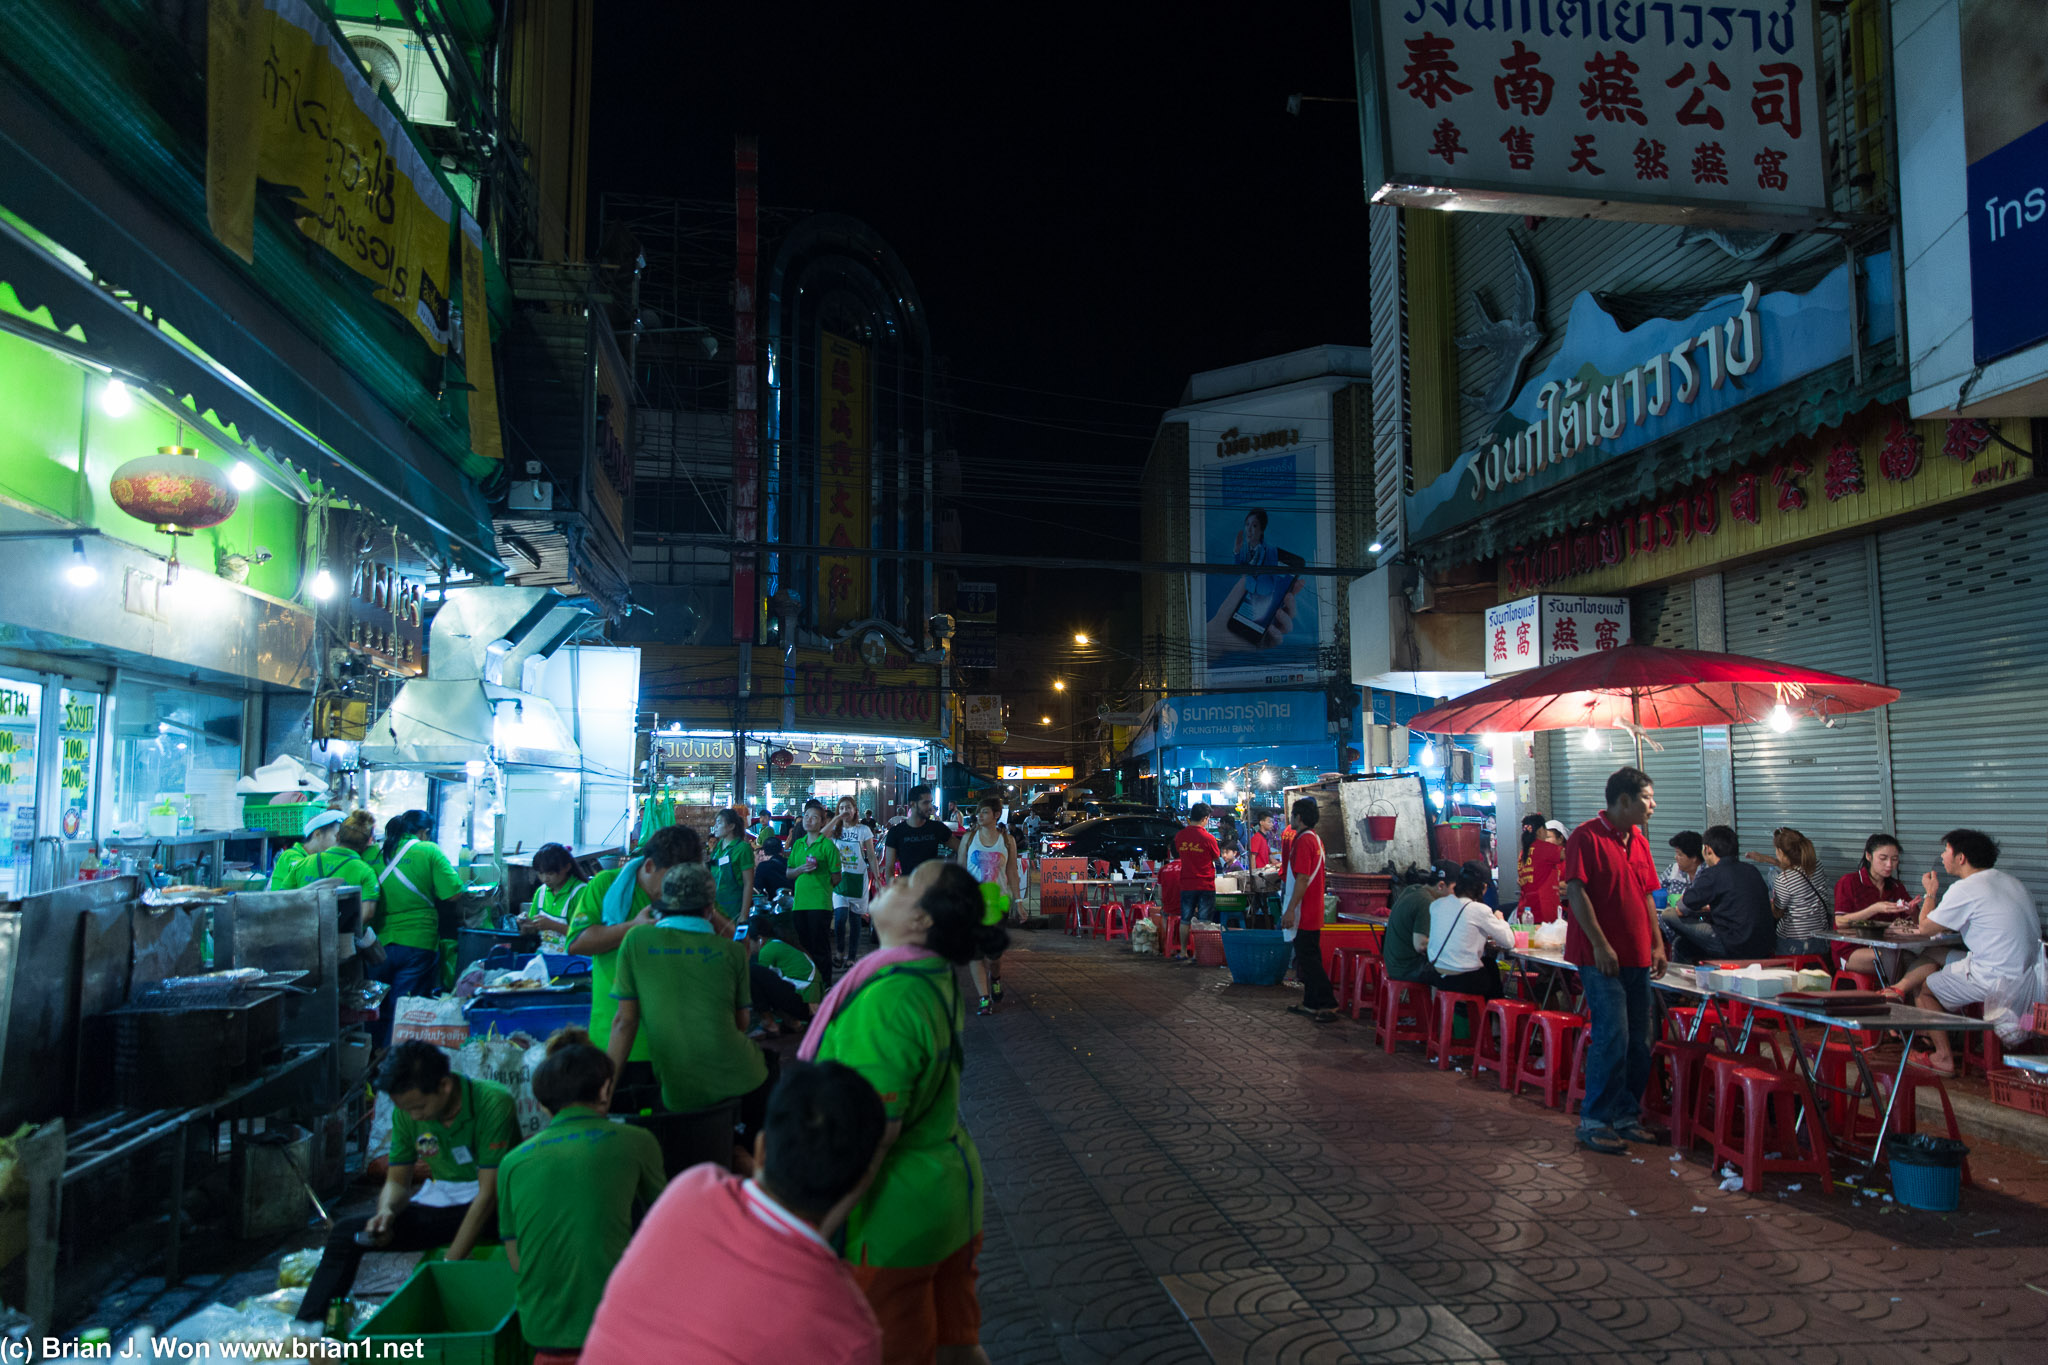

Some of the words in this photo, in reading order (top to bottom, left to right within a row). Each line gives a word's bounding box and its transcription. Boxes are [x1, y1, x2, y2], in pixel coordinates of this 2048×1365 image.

[1398, 32, 1803, 140] 泰南燕公司
[1467, 281, 1766, 502] รังนกใต้เยาวราช
[65, 696, 94, 731] รังนก
[1182, 726, 1231, 736] KRUNGTHAI
[1232, 724, 1256, 734] BANK
[1183, 701, 1291, 724] ธนาคารกรุงไทย
